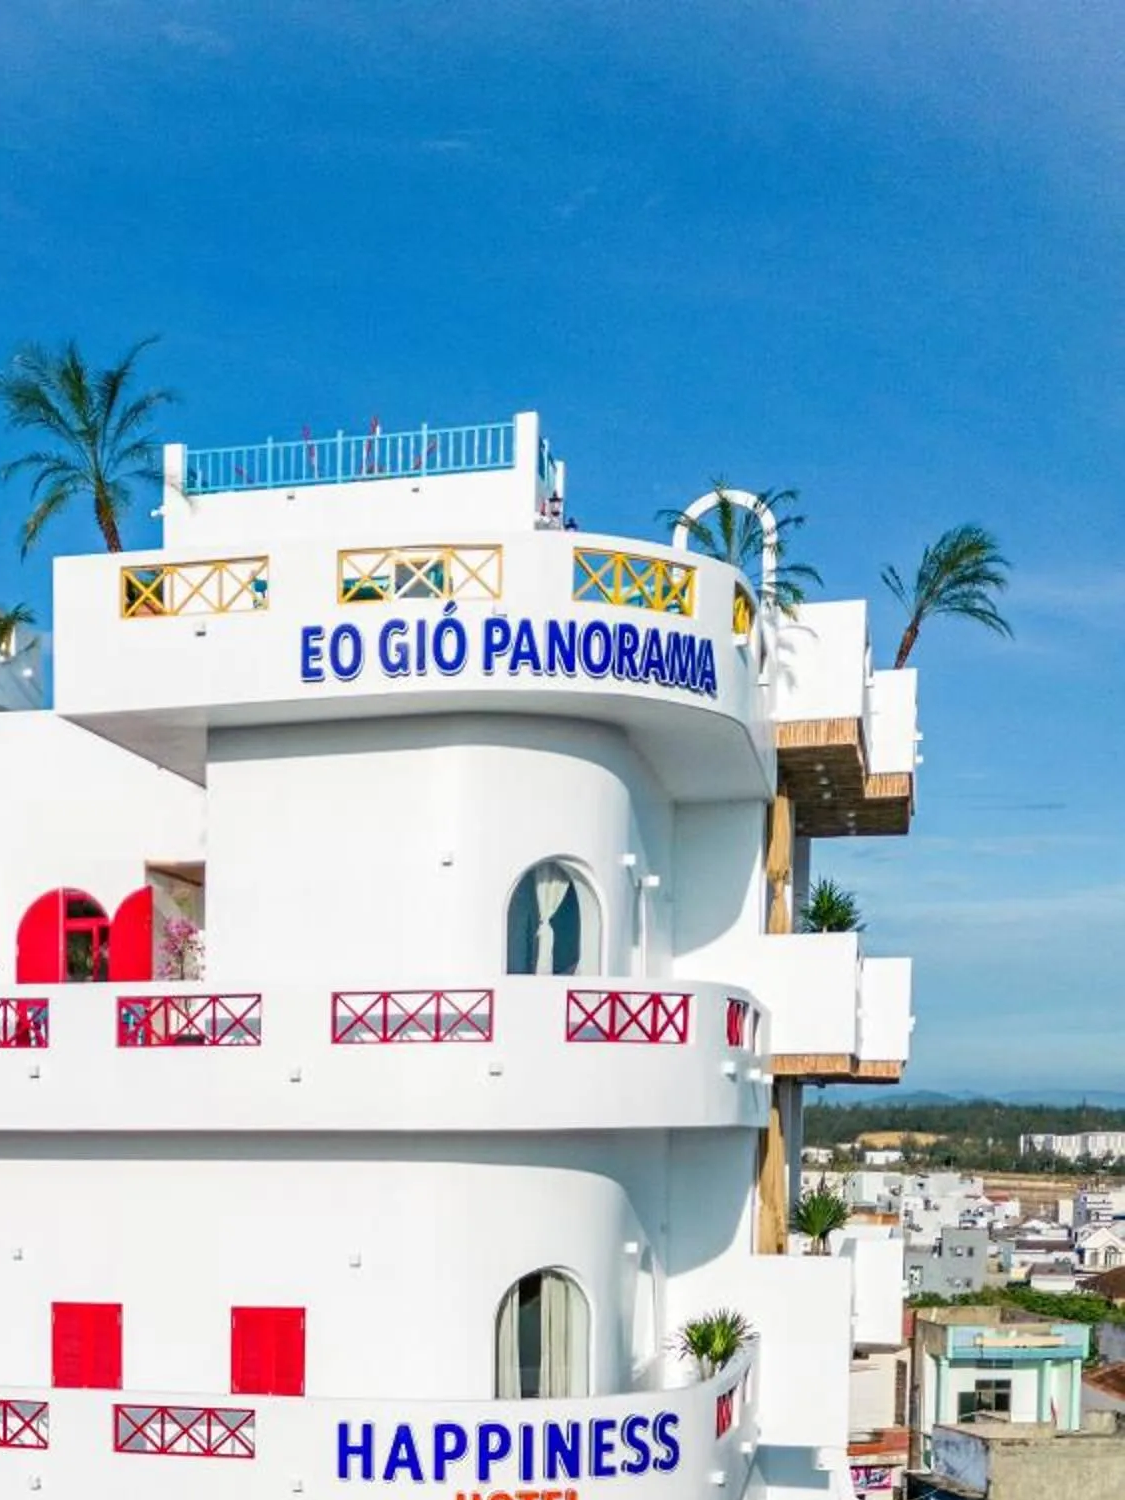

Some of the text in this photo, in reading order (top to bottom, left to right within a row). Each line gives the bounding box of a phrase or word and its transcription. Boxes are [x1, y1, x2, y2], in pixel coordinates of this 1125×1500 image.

[299, 600, 717, 697] EO GIÓ PANORAMA
[337, 1412, 680, 1483] HAPPINESS
